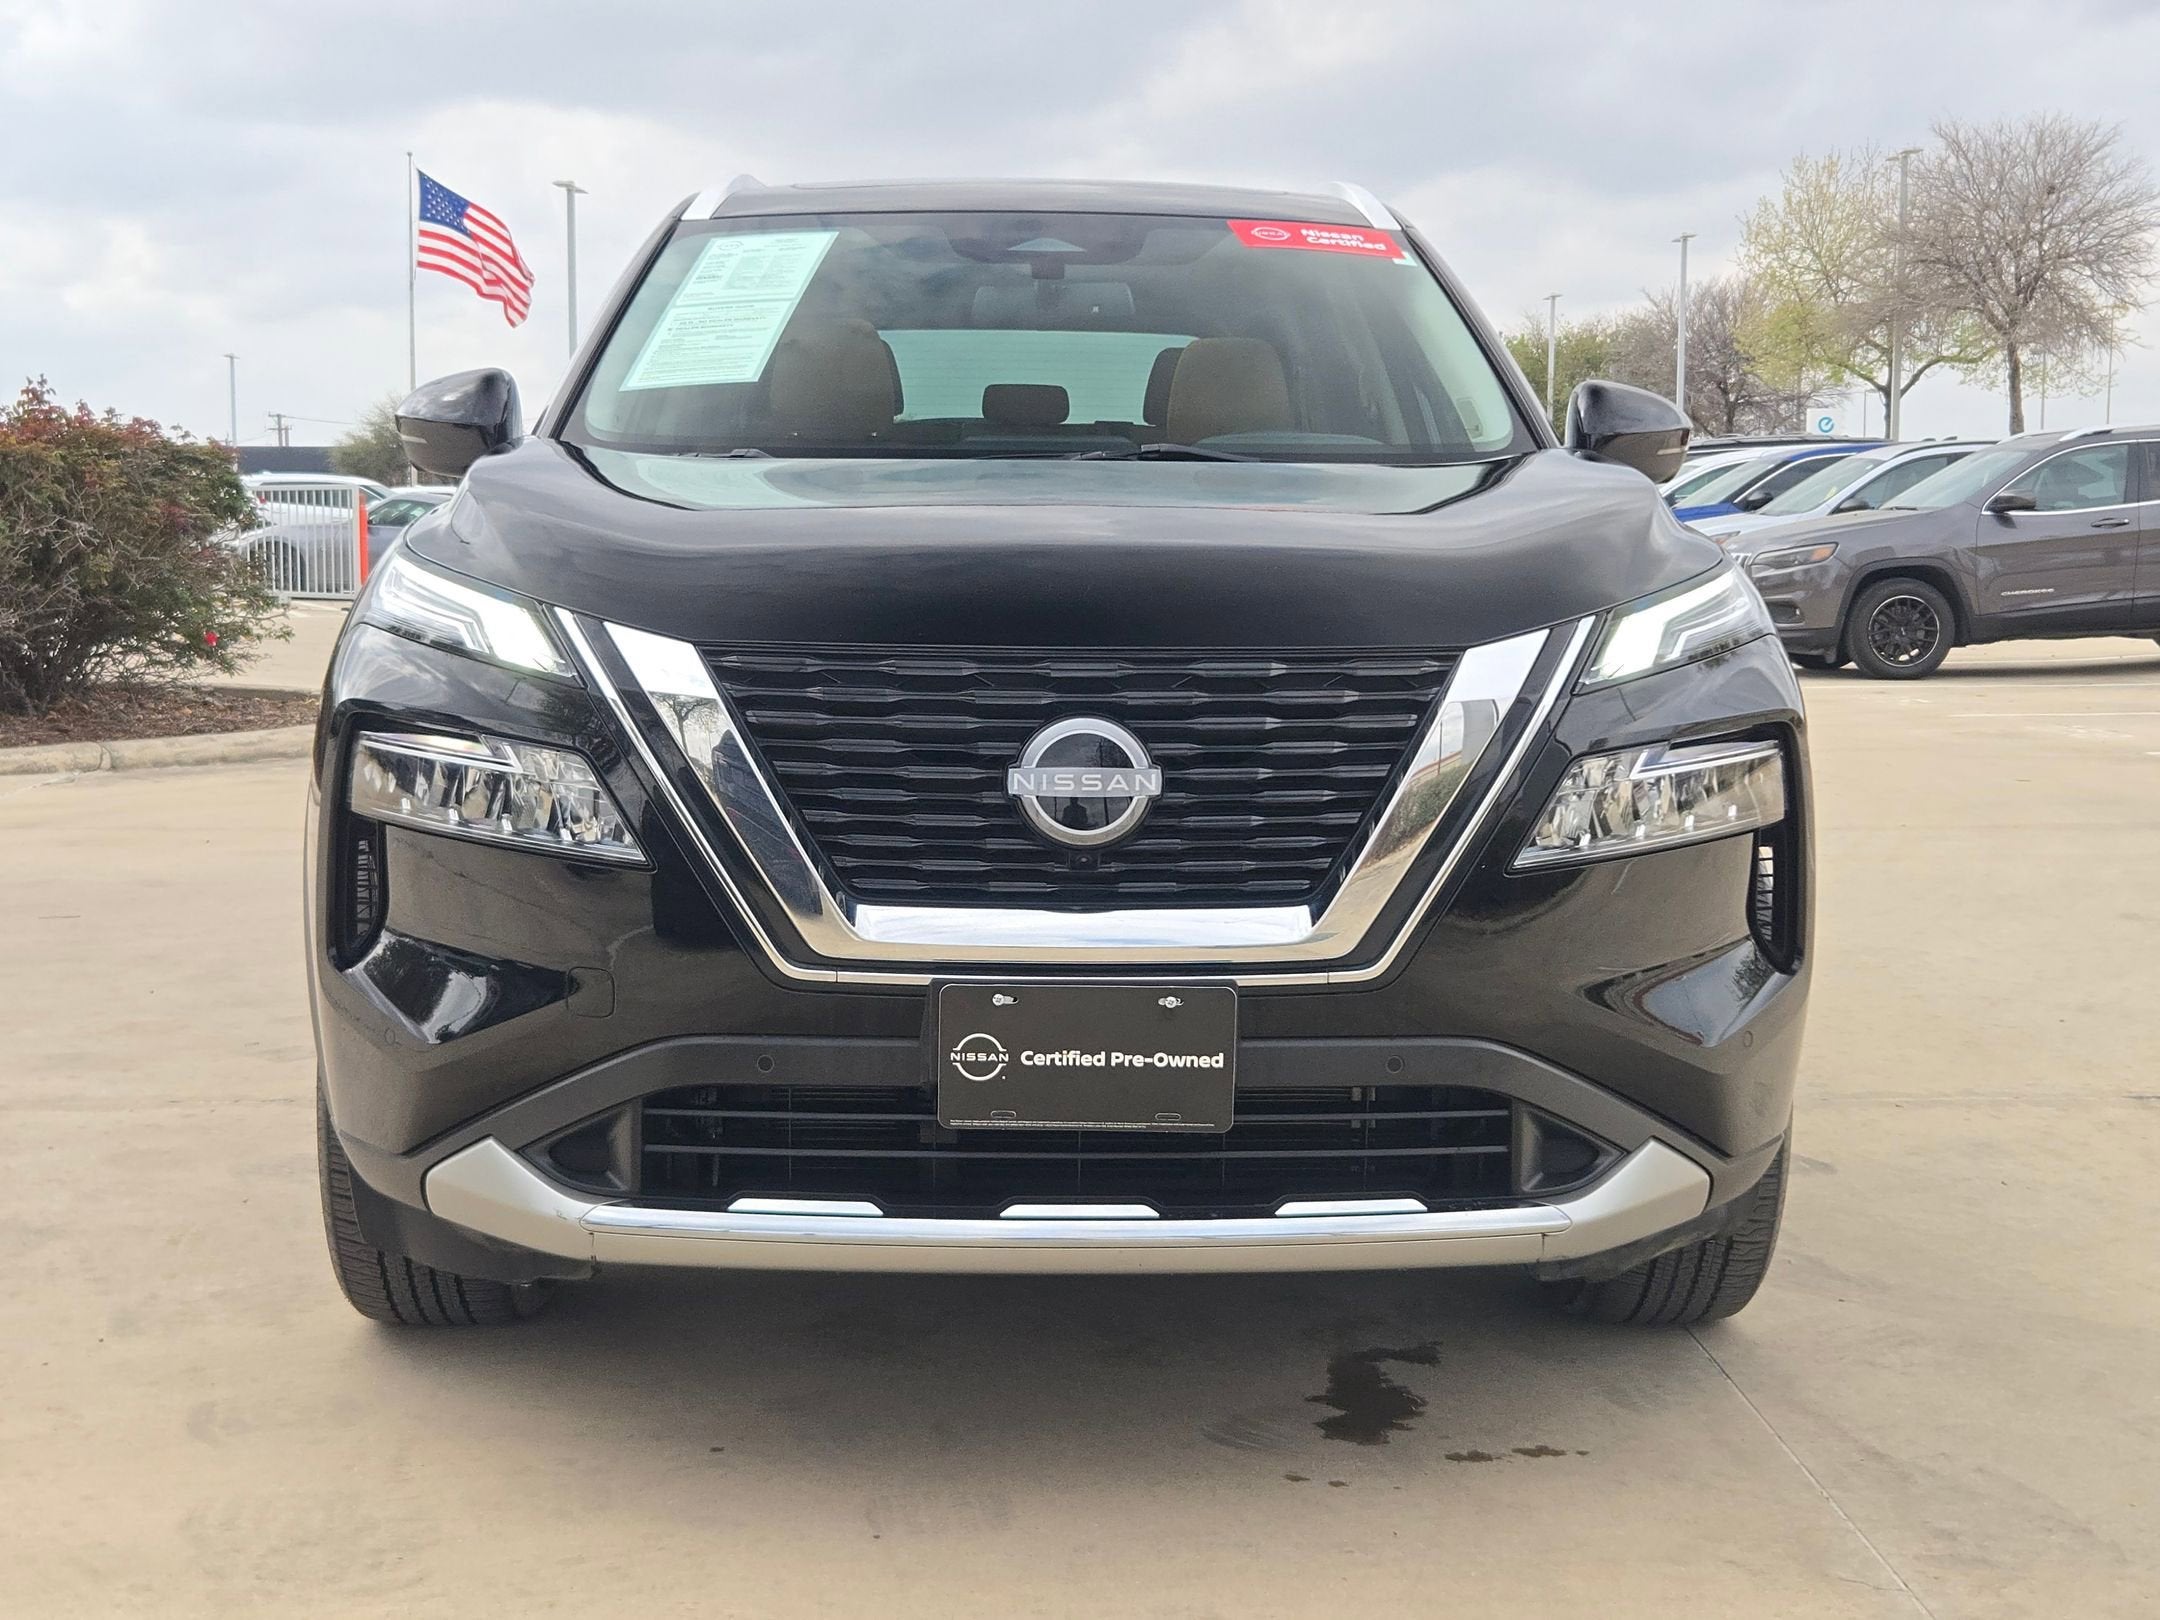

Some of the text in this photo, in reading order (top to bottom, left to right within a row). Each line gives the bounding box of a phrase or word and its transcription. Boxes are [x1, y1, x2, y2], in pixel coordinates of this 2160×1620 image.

[1301, 229, 1363, 241] Nissan
[1306, 236, 1386, 250] Certified
[1013, 773, 1156, 791] NISSAN
[950, 1052, 1009, 1063] NISSAN
[1020, 1049, 1225, 1069] Certified Pre-Owned
